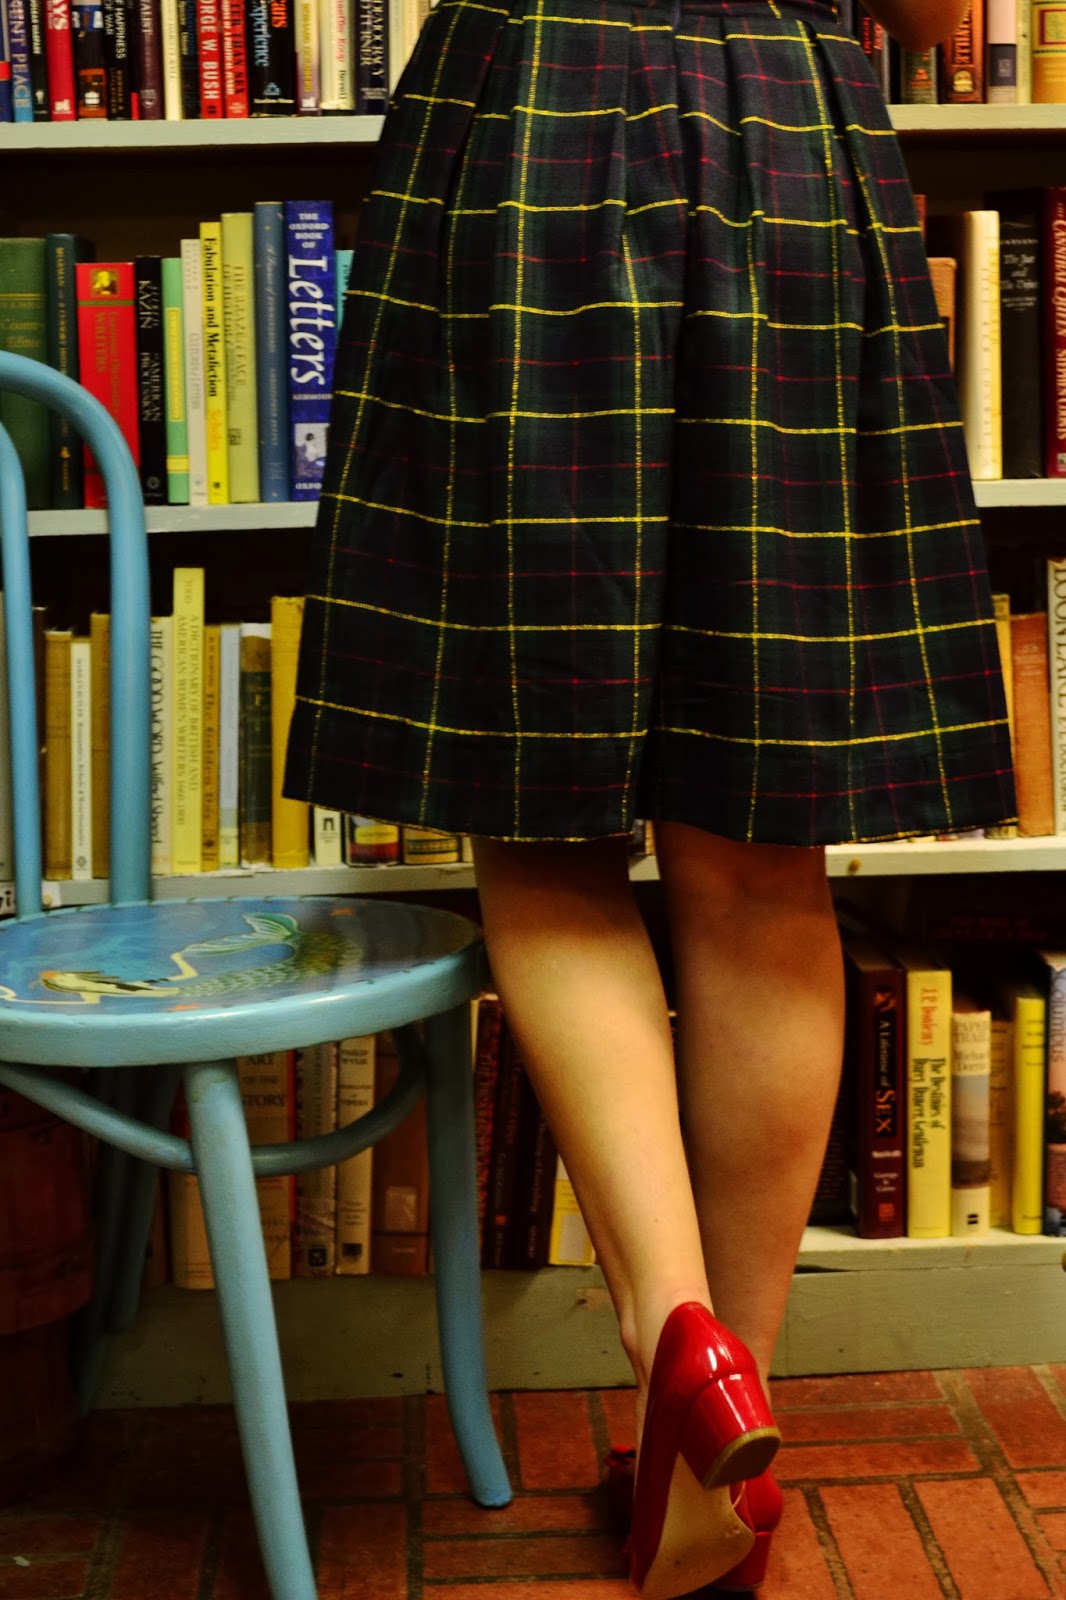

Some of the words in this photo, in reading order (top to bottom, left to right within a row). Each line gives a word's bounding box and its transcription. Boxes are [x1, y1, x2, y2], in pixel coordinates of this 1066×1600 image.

[104, 14, 114, 35] WAR
[115, 8, 127, 60] HAPPINESS
[201, 38, 218, 55] W.
[12, 54, 31, 108] PEACE
[203, 61, 220, 99] BUSH
[288, 222, 330, 231] OXFORD
[295, 232, 324, 241] BOOK
[298, 212, 319, 221] THE
[301, 241, 317, 249] OF
[1051, 219, 1066, 282] CANNIBAL
[204, 237, 217, 302] Fabulation
[139, 280, 152, 329] KAZIN
[206, 306, 219, 329] and
[288, 253, 335, 386] Letters
[1051, 286, 1066, 337] QUEEN
[95, 311, 107, 373] WRITERS
[207, 332, 221, 397] Metafiction
[151, 629, 164, 649] THE
[177, 615, 187, 674] AMERICAN
[190, 625, 200, 695] DICTIONARY
[151, 655, 164, 704] GOOD
[177, 677, 187, 722] WOMEN
[151, 708, 164, 754] WORD
[177, 725, 187, 777] WRITERS
[189, 717, 199, 763] BRITISH
[189, 766, 199, 791] AND
[911, 1057, 929, 1083] Darcy
[930, 1057, 946, 1074] The
[876, 1089, 896, 1133] SEX
[931, 1119, 946, 1129] of
[913, 1120, 929, 1168] Gentleman
